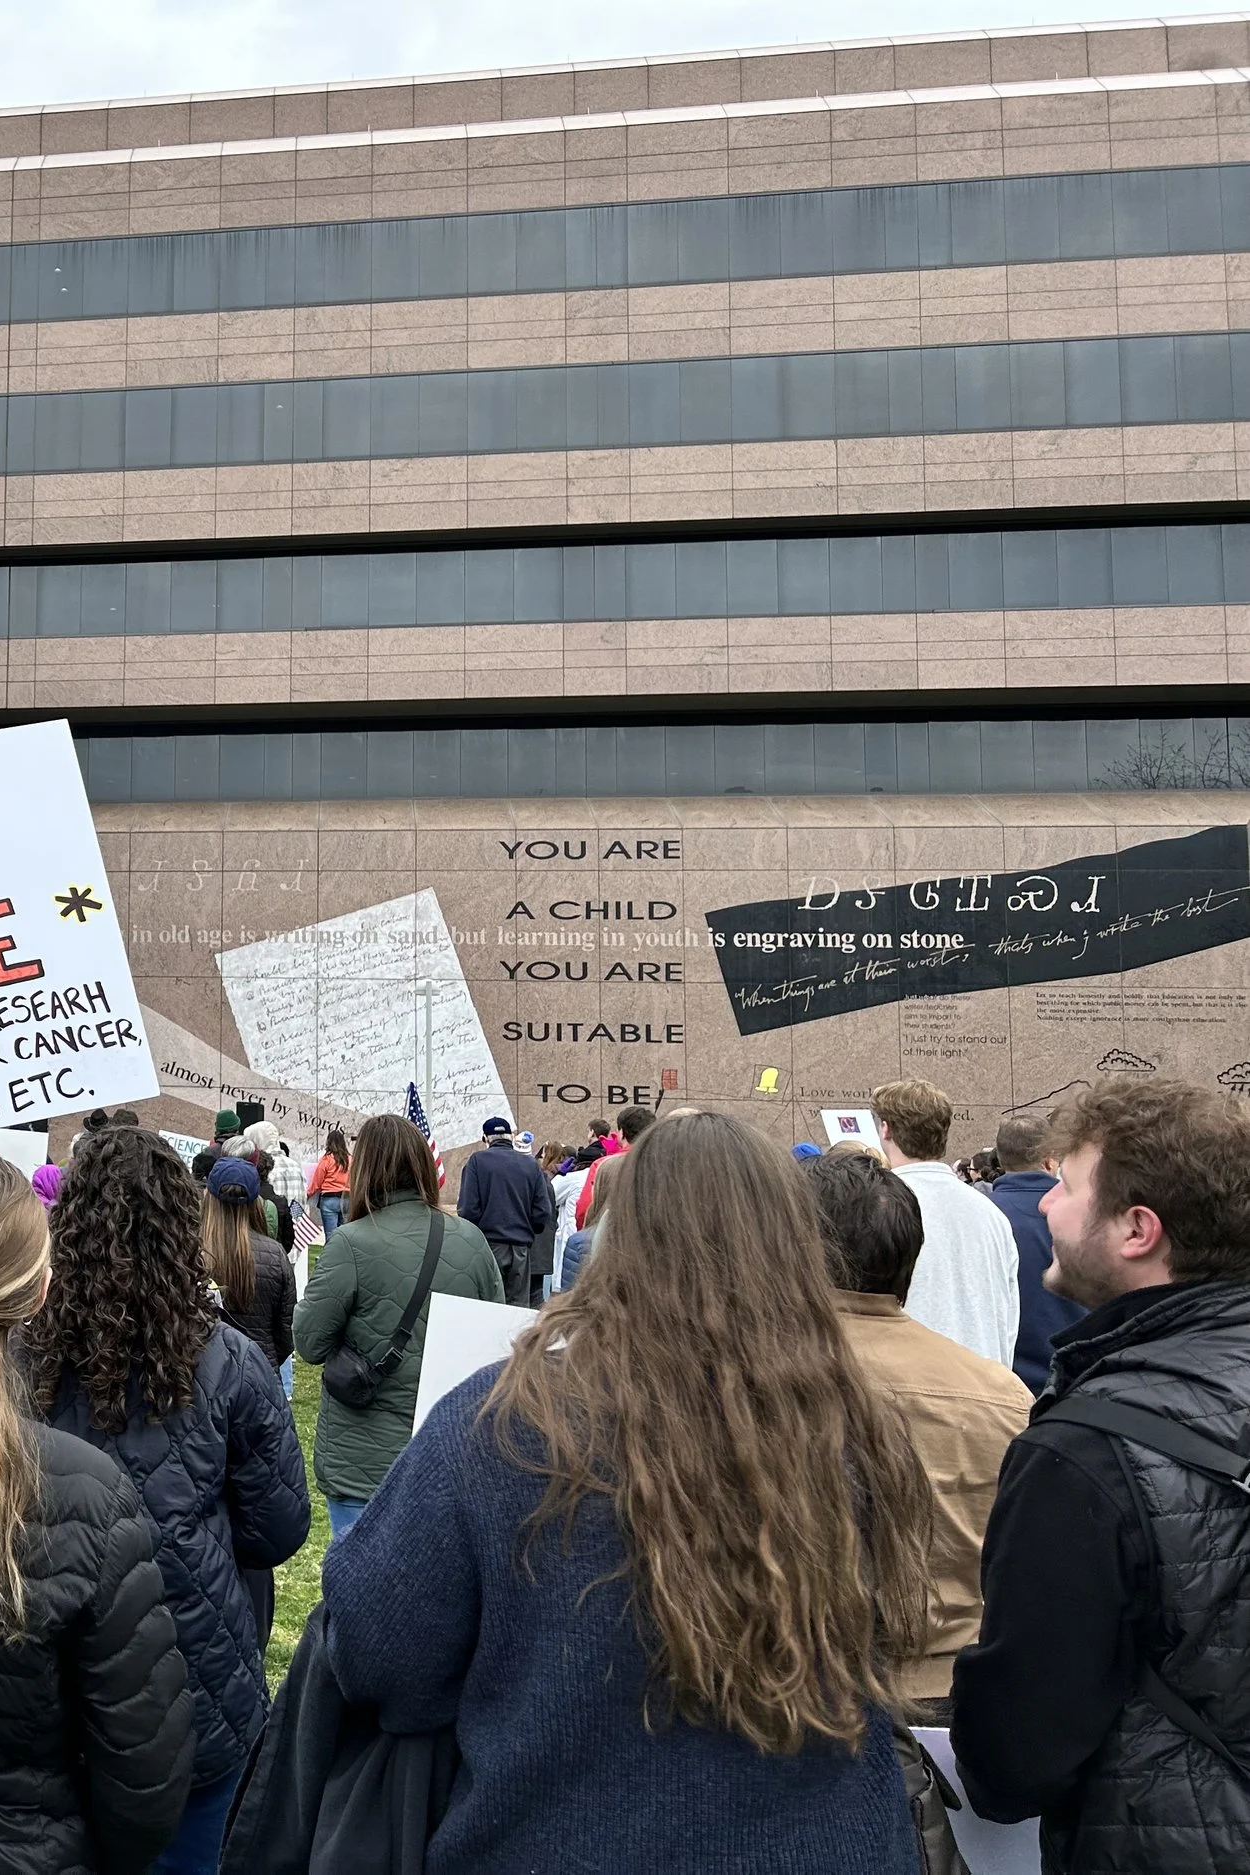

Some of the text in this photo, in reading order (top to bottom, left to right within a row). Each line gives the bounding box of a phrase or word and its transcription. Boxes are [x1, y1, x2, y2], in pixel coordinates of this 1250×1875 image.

[499, 841, 681, 859] YOU ARE
[505, 901, 677, 920] A CHILD
[132, 924, 152, 943] in
[158, 925, 190, 943] old
[197, 931, 233, 948] age
[240, 924, 256, 943] is
[264, 925, 344, 949] writing
[451, 926, 487, 945] but
[498, 926, 595, 951] learning
[603, 927, 626, 946] in
[633, 927, 699, 951] youth
[707, 927, 726, 946] is
[733, 927, 858, 953] engraving
[862, 931, 894, 949] on
[899, 930, 965, 949] stone
[499, 961, 683, 982] YOU ARE
[818, 979, 838, 990] are
[1219, 993, 1233, 1001] only
[14, 1018, 142, 1059] CANCER,
[502, 1021, 684, 1043] SUITABLE
[910, 1034, 926, 1044] just
[930, 1034, 942, 1044] try
[945, 1034, 956, 1043] to
[958, 1034, 988, 1044] stand
[990, 1035, 1007, 1044] out
[902, 1047, 913, 1056] of
[916, 1047, 938, 1057] their
[8, 1068, 95, 1112] ETC.
[160, 1061, 346, 1134] almost never by words
[536, 1084, 650, 1105] TO BE
[799, 1086, 835, 1098] Love
